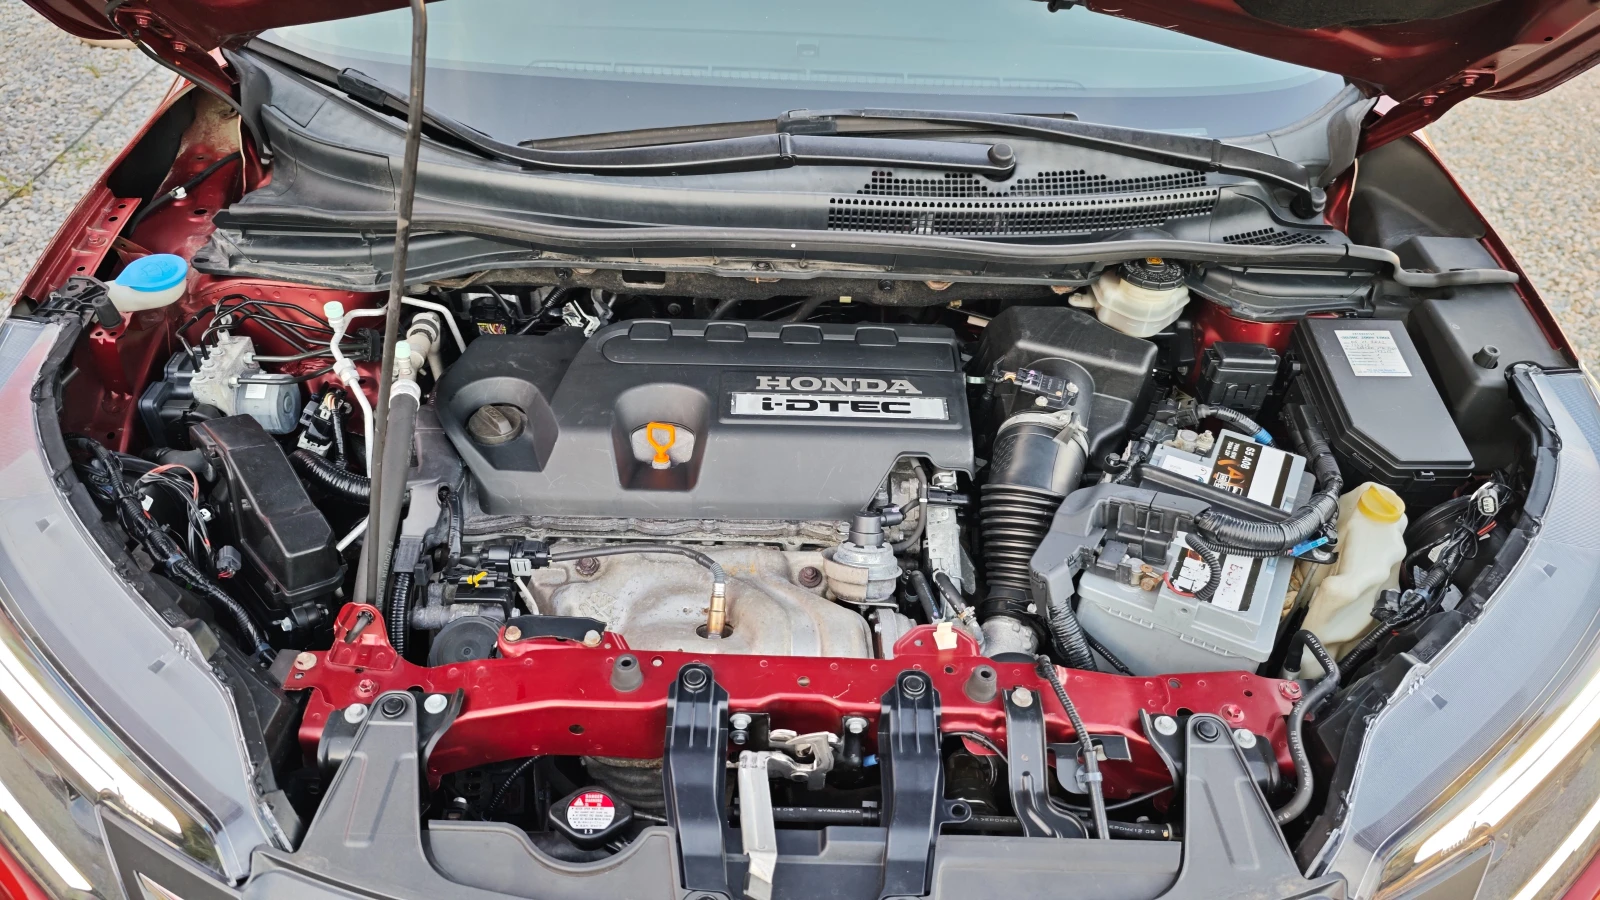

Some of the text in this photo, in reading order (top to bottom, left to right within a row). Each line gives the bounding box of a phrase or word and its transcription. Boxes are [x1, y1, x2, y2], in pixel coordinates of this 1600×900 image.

[755, 375, 922, 394] HONDA
[762, 397, 912, 414] i-DTEC
[1240, 446, 1256, 470] S5 A08
